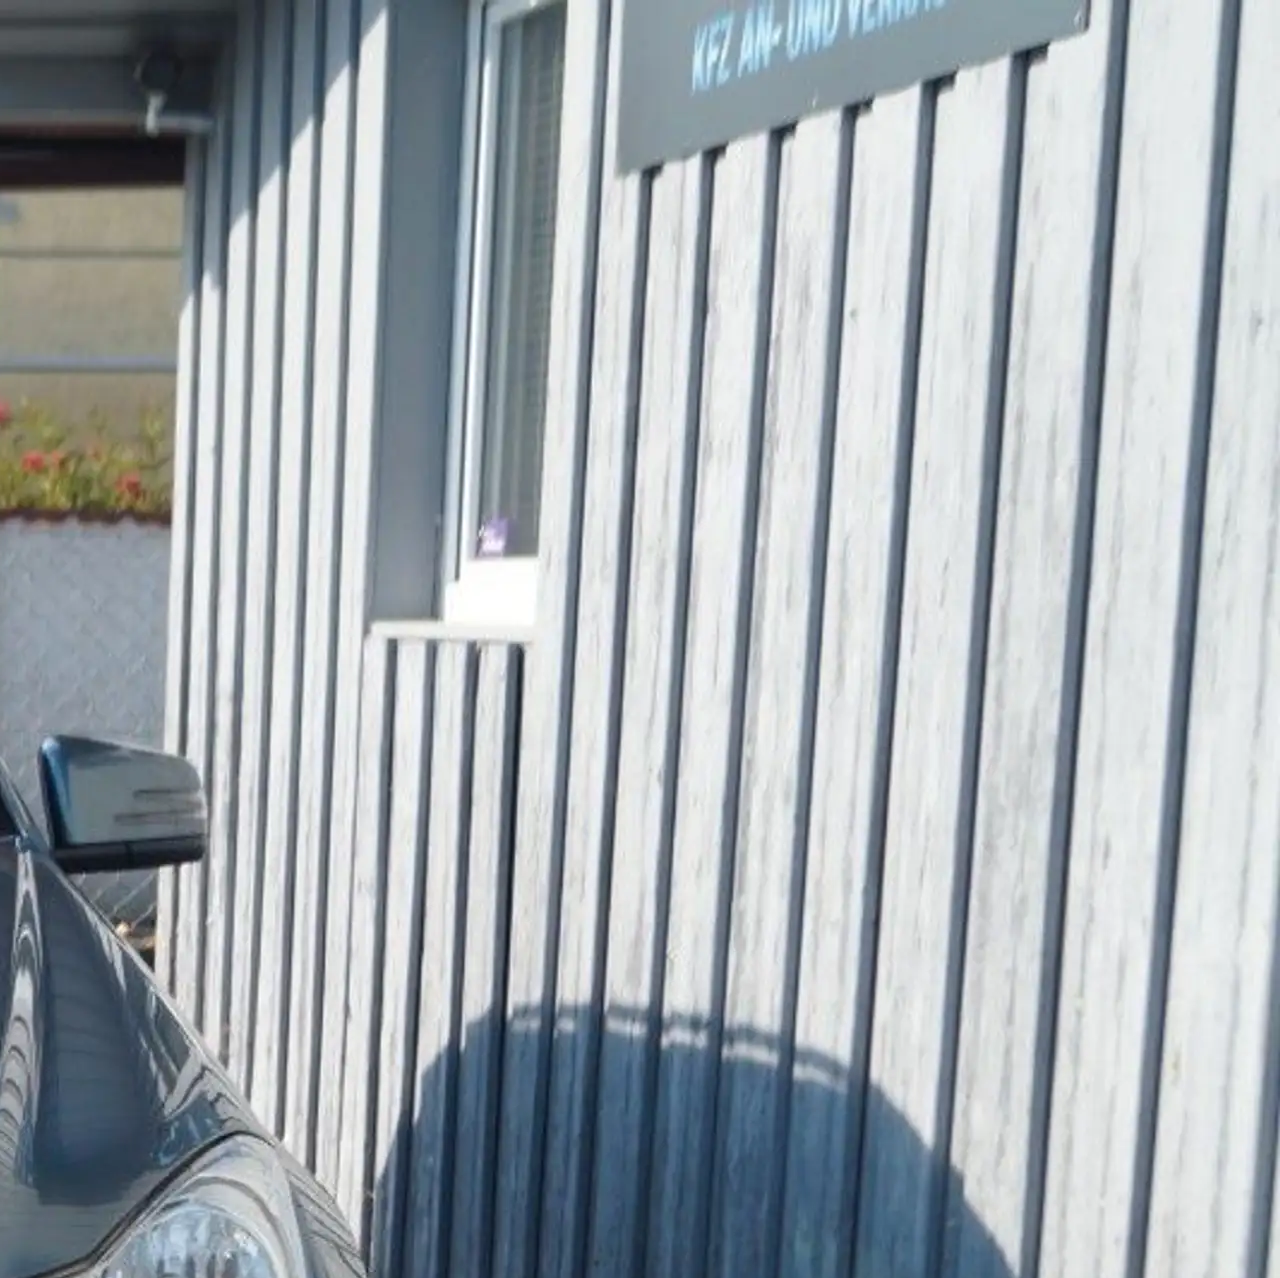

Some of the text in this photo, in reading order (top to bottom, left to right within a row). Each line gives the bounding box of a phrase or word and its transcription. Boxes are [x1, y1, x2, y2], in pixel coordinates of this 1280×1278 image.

[691, 12, 735, 94] KFZ
[738, 2, 783, 77] AN-
[786, 0, 839, 62] UND
